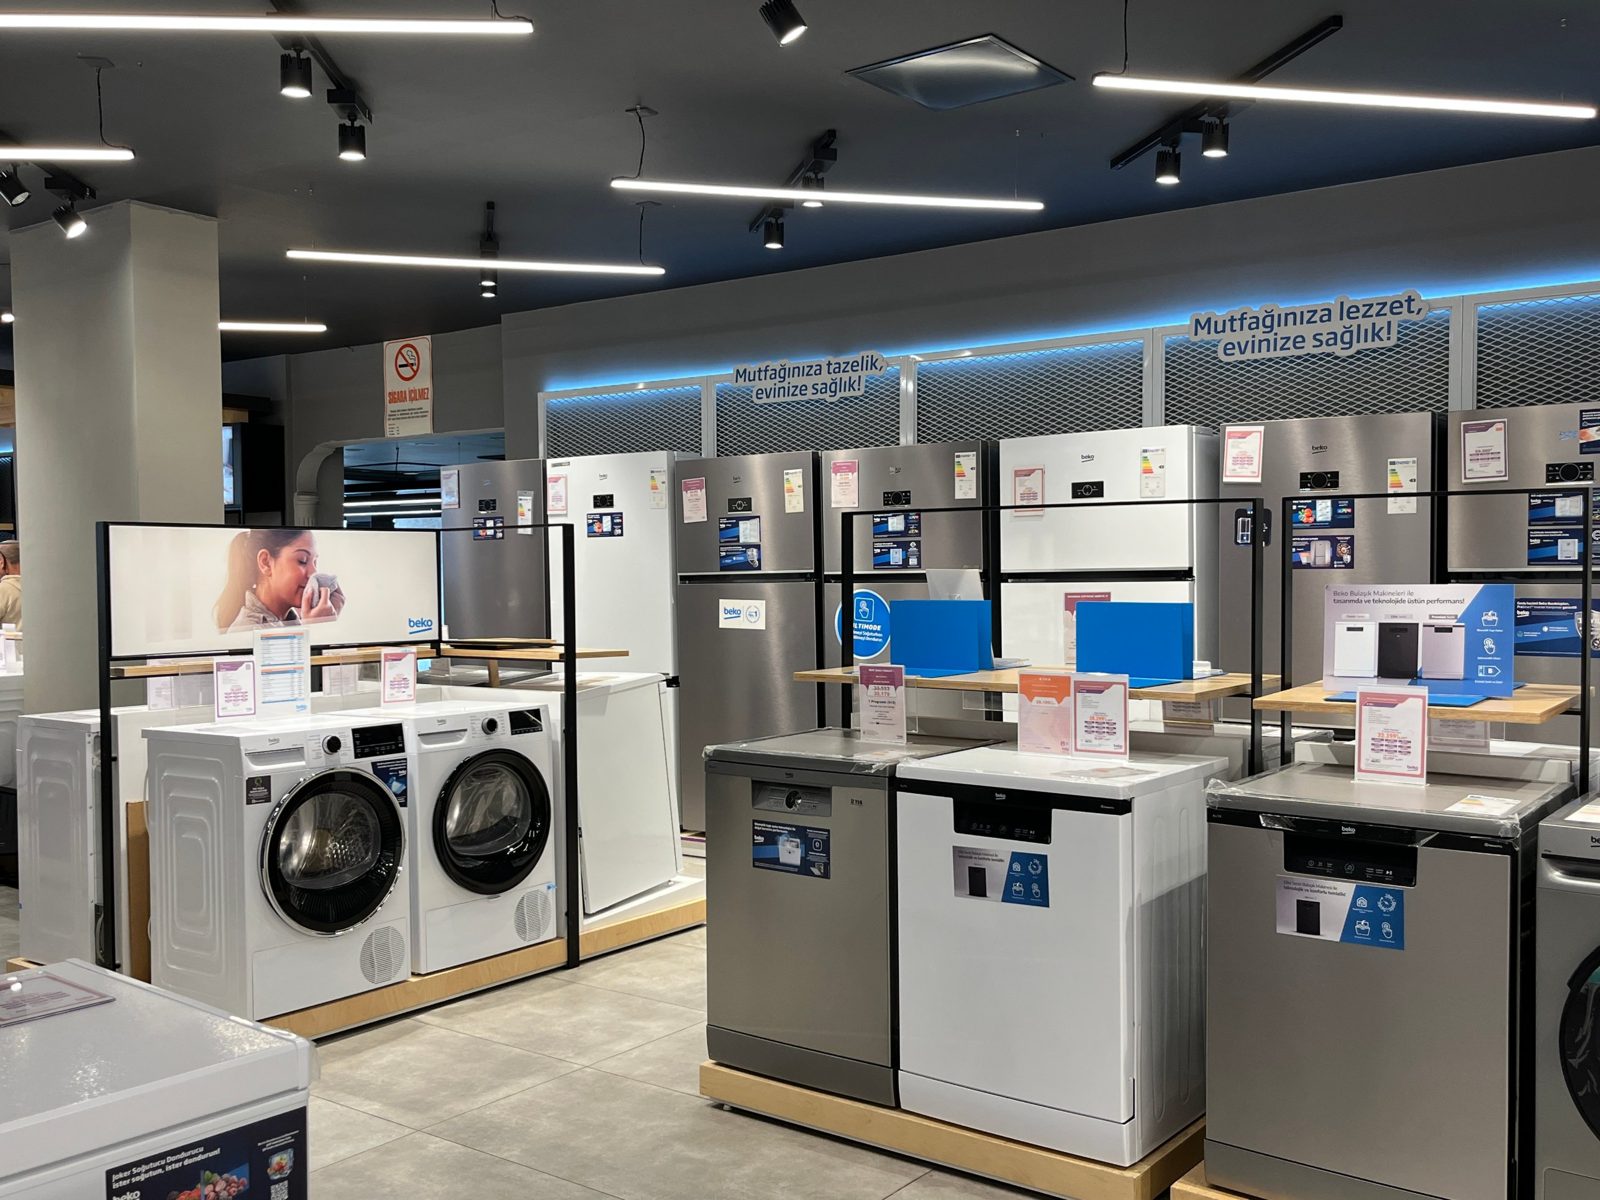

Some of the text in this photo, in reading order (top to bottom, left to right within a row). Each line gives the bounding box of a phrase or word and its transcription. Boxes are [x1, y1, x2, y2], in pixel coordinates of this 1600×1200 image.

[1193, 294, 1424, 337] Mutfağınıza lezzet,
[1222, 320, 1393, 357] evinize sağlık!
[735, 354, 884, 384] Mutfağınıza tazelik,
[755, 375, 862, 400] evinize sağlık!
[1311, 445, 1328, 453] beko
[408, 618, 433, 630] beko
[724, 607, 742, 616] beko
[112, 1147, 204, 1182] Joker Soğutucu Dondurucu
[112, 1147, 221, 1189] ister soğutun, ister dondurun!
